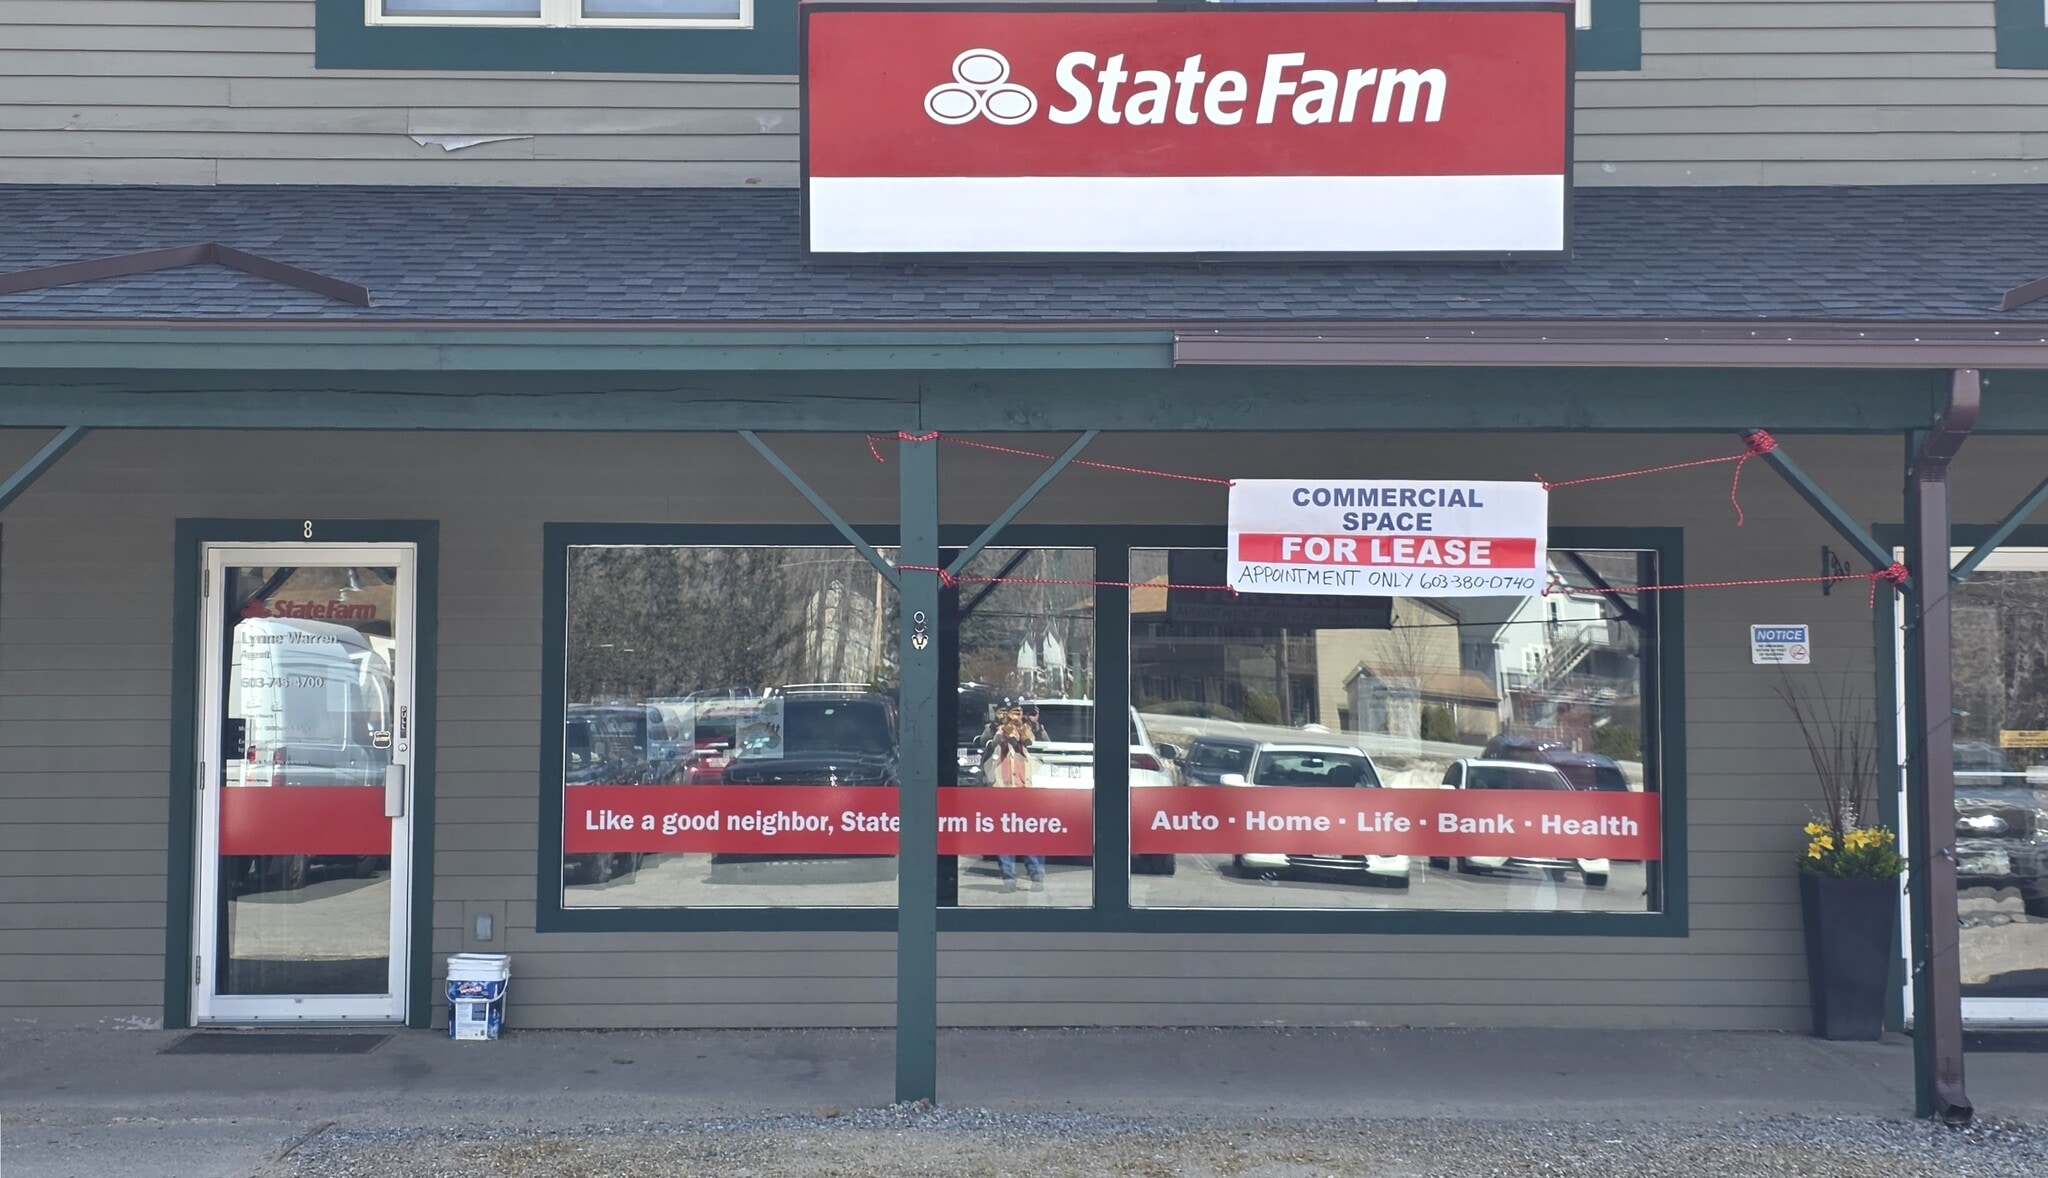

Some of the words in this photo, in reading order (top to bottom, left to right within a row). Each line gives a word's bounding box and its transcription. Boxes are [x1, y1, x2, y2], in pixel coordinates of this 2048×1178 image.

[1292, 487, 1484, 508] COMMERCIAL
[303, 520, 313, 539] 8
[1342, 512, 1433, 531] SPACE
[1281, 537, 1358, 562] FOR
[1370, 538, 1492, 565] LEASE
[1238, 565, 1362, 586] APPOINTMENT
[1368, 572, 1414, 588] ONLY
[1419, 573, 1536, 589] 603-380-0740
[241, 632, 284, 646] Lynne
[288, 632, 339, 645] Warren
[1756, 630, 1803, 640] NOTICE
[586, 810, 634, 830] Like
[641, 815, 655, 830] a
[662, 811, 719, 835] good
[727, 811, 834, 836] neighbor,
[841, 811, 900, 832] State
[975, 812, 994, 832] is
[1001, 813, 1068, 833] there.
[1151, 811, 1219, 831] Auto
[1245, 812, 1331, 831] Home
[1357, 812, 1411, 832] Life
[1438, 814, 1514, 834] Bank
[1541, 816, 1638, 836] Health
